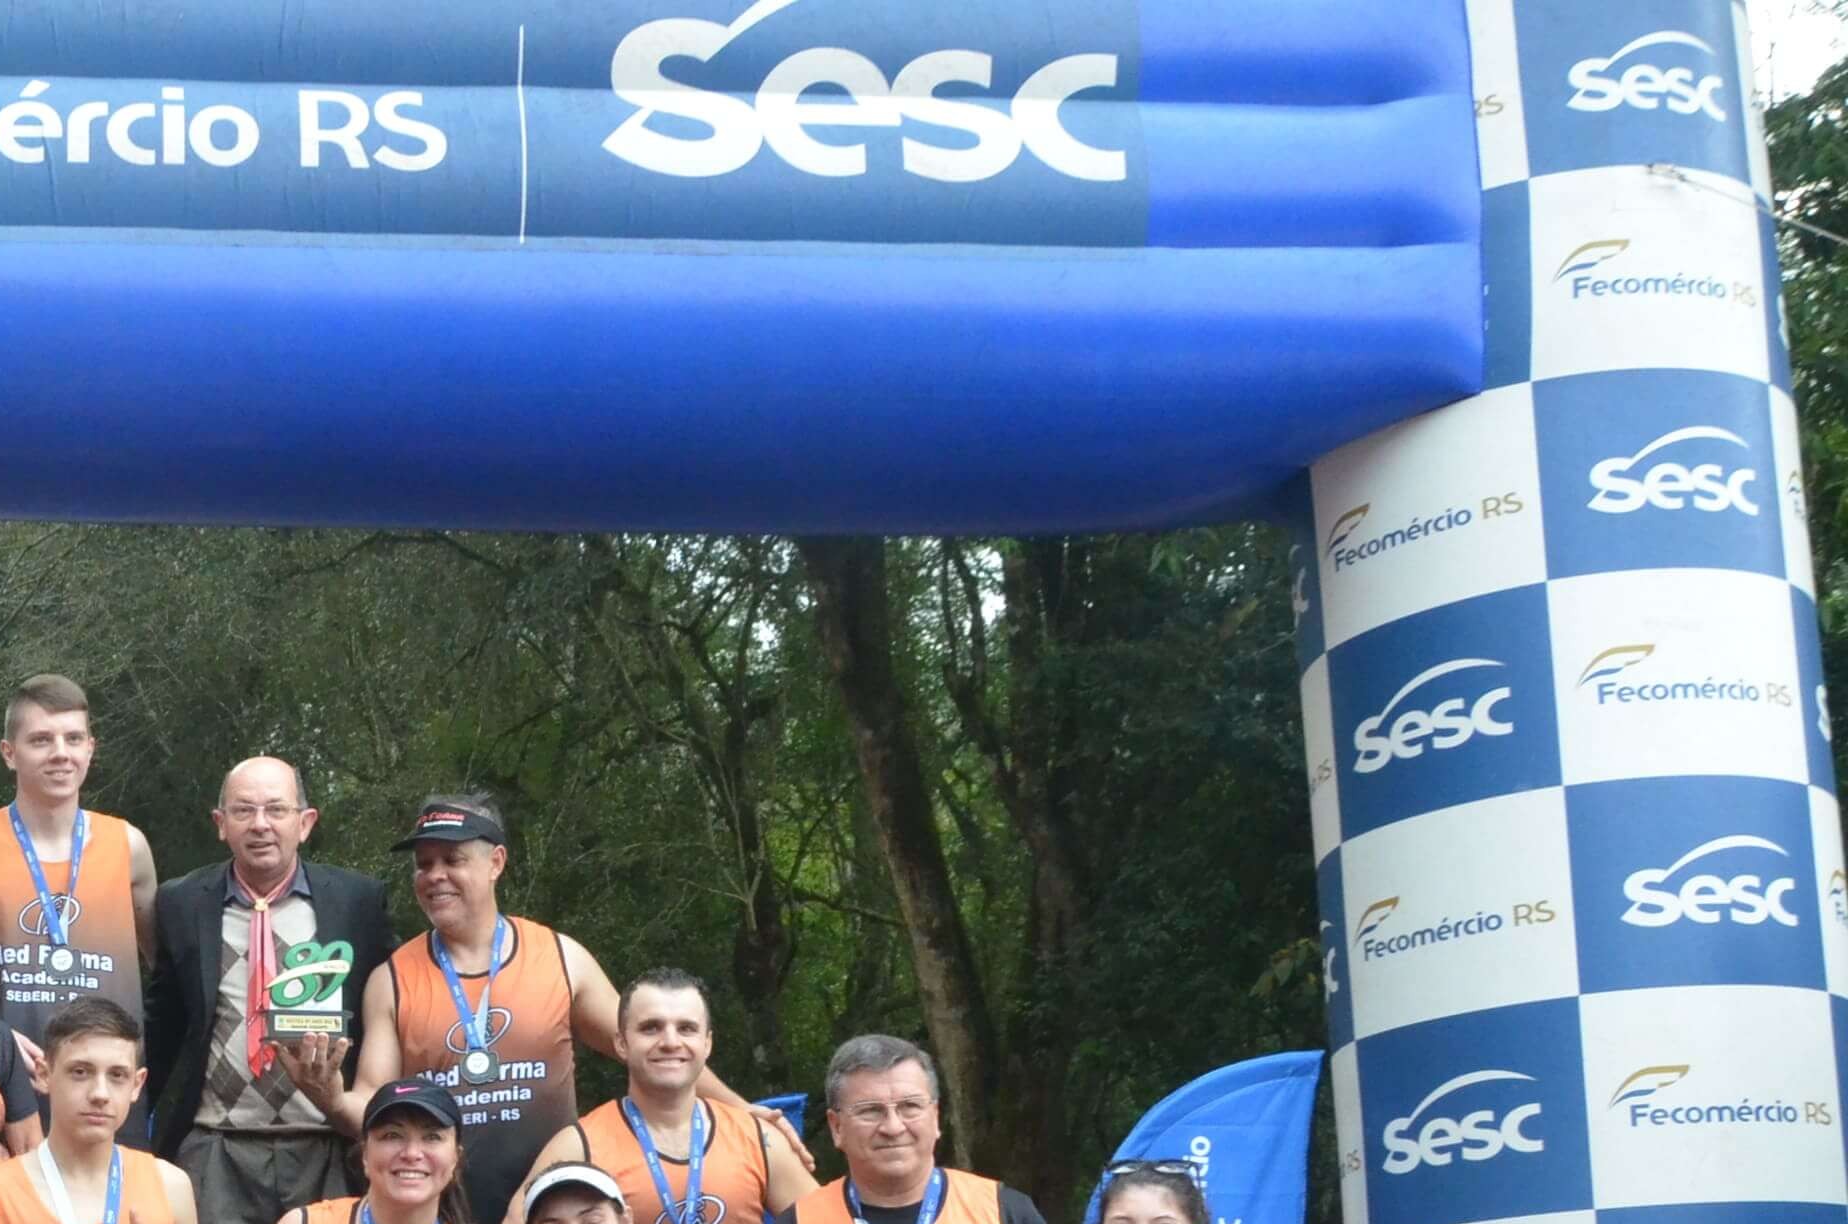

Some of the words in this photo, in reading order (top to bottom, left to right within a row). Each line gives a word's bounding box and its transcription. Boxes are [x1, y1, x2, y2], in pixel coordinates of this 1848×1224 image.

[300, 90, 448, 172] RS
[1572, 271, 1727, 300] Fecomércio
[1732, 281, 1757, 308] RS
[1334, 504, 1472, 573] Fecomércio
[1482, 491, 1524, 520] RS
[1597, 676, 1759, 705] Fecomércio
[1765, 682, 1793, 708] RS
[1362, 908, 1503, 961] Fecomércio
[1513, 899, 1557, 928] RS
[38, 944, 113, 972] Fma
[6, 989, 57, 1002] SEBERI
[452, 1085, 532, 1106] ademia
[500, 1107, 521, 1121] RS
[1630, 1098, 1799, 1128] Fecomércio
[1804, 1101, 1833, 1128] RS
